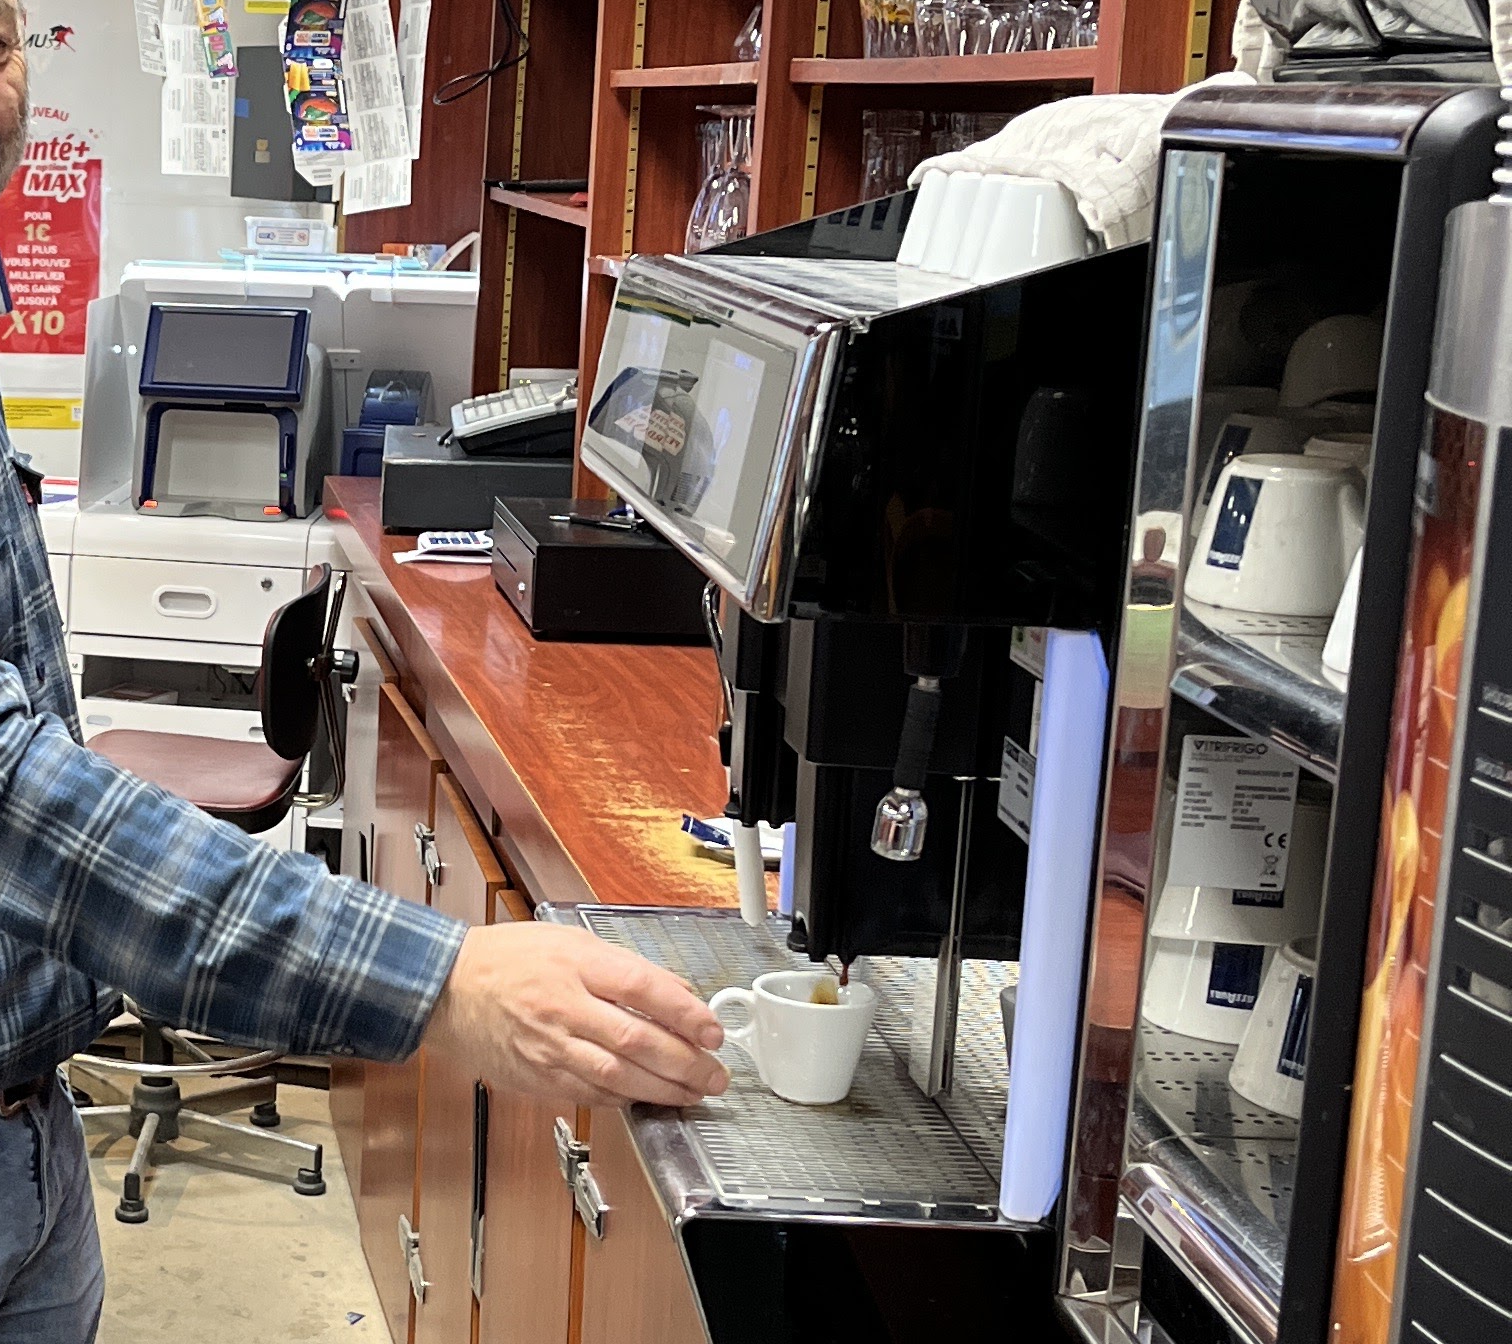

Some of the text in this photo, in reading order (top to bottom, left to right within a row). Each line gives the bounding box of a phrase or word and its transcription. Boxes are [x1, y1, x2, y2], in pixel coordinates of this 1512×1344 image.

[28, 173, 82, 197] MAX
[24, 211, 52, 221] POUR
[24, 223, 51, 242] 1€
[17, 244, 58, 254] DE PLUS
[4, 258, 71, 268] VOUS POUVEZ
[9, 271, 65, 280] MULTIPLIER
[9, 284, 61, 293] VOS GAINS
[16, 295, 58, 306] JUSQU'À
[1, 310, 65, 340] X10
[1194, 740, 1269, 755] VITRIFRIGO
